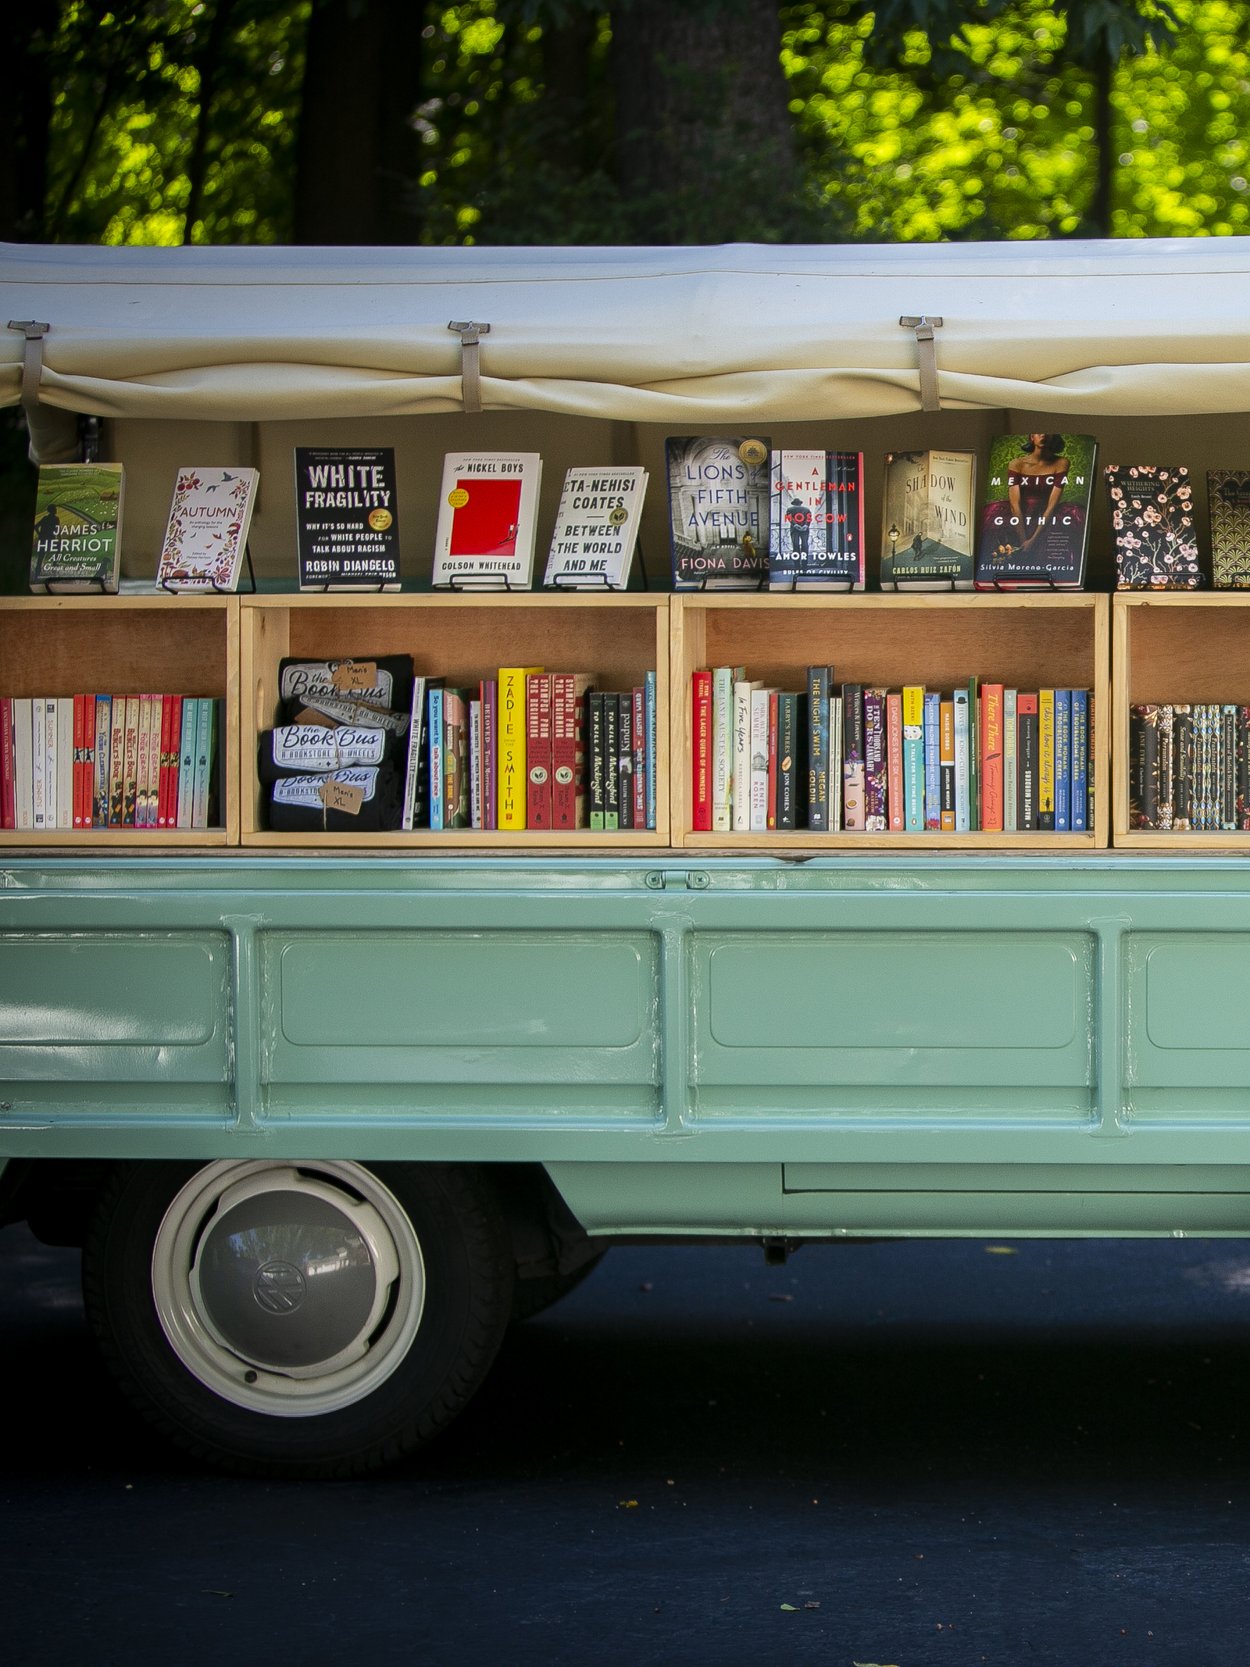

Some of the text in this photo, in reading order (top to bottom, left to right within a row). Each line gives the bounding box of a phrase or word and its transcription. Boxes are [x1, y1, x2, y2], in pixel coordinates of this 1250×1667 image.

[710, 448, 730, 460] The
[467, 463, 524, 473] NICKEL BOYS
[687, 465, 745, 480] LIONS
[812, 467, 819, 475] A
[308, 464, 385, 488] WHITE
[991, 476, 1085, 486] MEXICAN
[570, 479, 635, 492] TA-NEHISI
[775, 482, 855, 491] GENTLEMAN
[906, 474, 956, 493] SHADOW
[305, 490, 391, 509] FRAGILITY
[698, 489, 748, 504] FIFTH
[809, 497, 822, 506] IN
[573, 497, 624, 509] COATES
[180, 507, 238, 518] AUTUMN
[785, 513, 847, 523] MOSCOW
[935, 505, 967, 527] WIND
[688, 512, 759, 527] AVENUE
[994, 516, 1072, 526] GOTHIC
[53, 525, 97, 535] JAMES
[565, 525, 620, 536] BETWEEN
[355, 533, 383, 541] PEOPLE
[37, 539, 112, 552] HERRIOT
[312, 544, 386, 553] TALK ABOUT RACISM
[557, 543, 622, 553] THE WORLD
[775, 552, 857, 561] AMOR TOWLES
[65, 563, 79, 571] and
[79, 563, 101, 571] Small
[305, 560, 395, 572] ROBIN DIANGELO
[442, 562, 521, 570] COLSON WHITEHEAD
[563, 560, 607, 571] AND ME
[682, 558, 770, 569] FIONA DAVIS
[1008, 563, 1074, 571] Moreno-Garcia
[921, 566, 937, 574] RUIZ
[347, 666, 368, 674] Men's
[312, 673, 327, 683] the
[351, 677, 364, 685] XL
[540, 679, 549, 712] STAMPED
[506, 676, 514, 735] ZADIE
[566, 679, 574, 738] STAMPED FROM
[718, 696, 726, 718] JANE
[1058, 702, 1062, 710] OF
[1074, 702, 1078, 710] OF
[530, 698, 538, 738] BEGINNING
[556, 698, 564, 738] BEGINNING
[812, 698, 820, 726] NIGHT
[540, 718, 549, 738] FROM
[988, 694, 998, 750] There There
[621, 713, 630, 751] Kindred
[736, 707, 746, 752] Five Years
[280, 726, 379, 748] Book Bus
[812, 730, 820, 756] SWIM
[874, 731, 882, 762] THOUSAND
[290, 749, 330, 758] BOOKSTORE
[347, 749, 375, 757] WHEELS
[410, 741, 418, 772] FRAGILITY
[1041, 734, 1052, 784] how always
[334, 770, 371, 783] Bus
[505, 751, 514, 810] SMITH
[590, 756, 602, 804] Mockingbird
[606, 756, 616, 804] Mockingbird
[333, 786, 353, 798] Men's
[333, 798, 346, 806] XL
